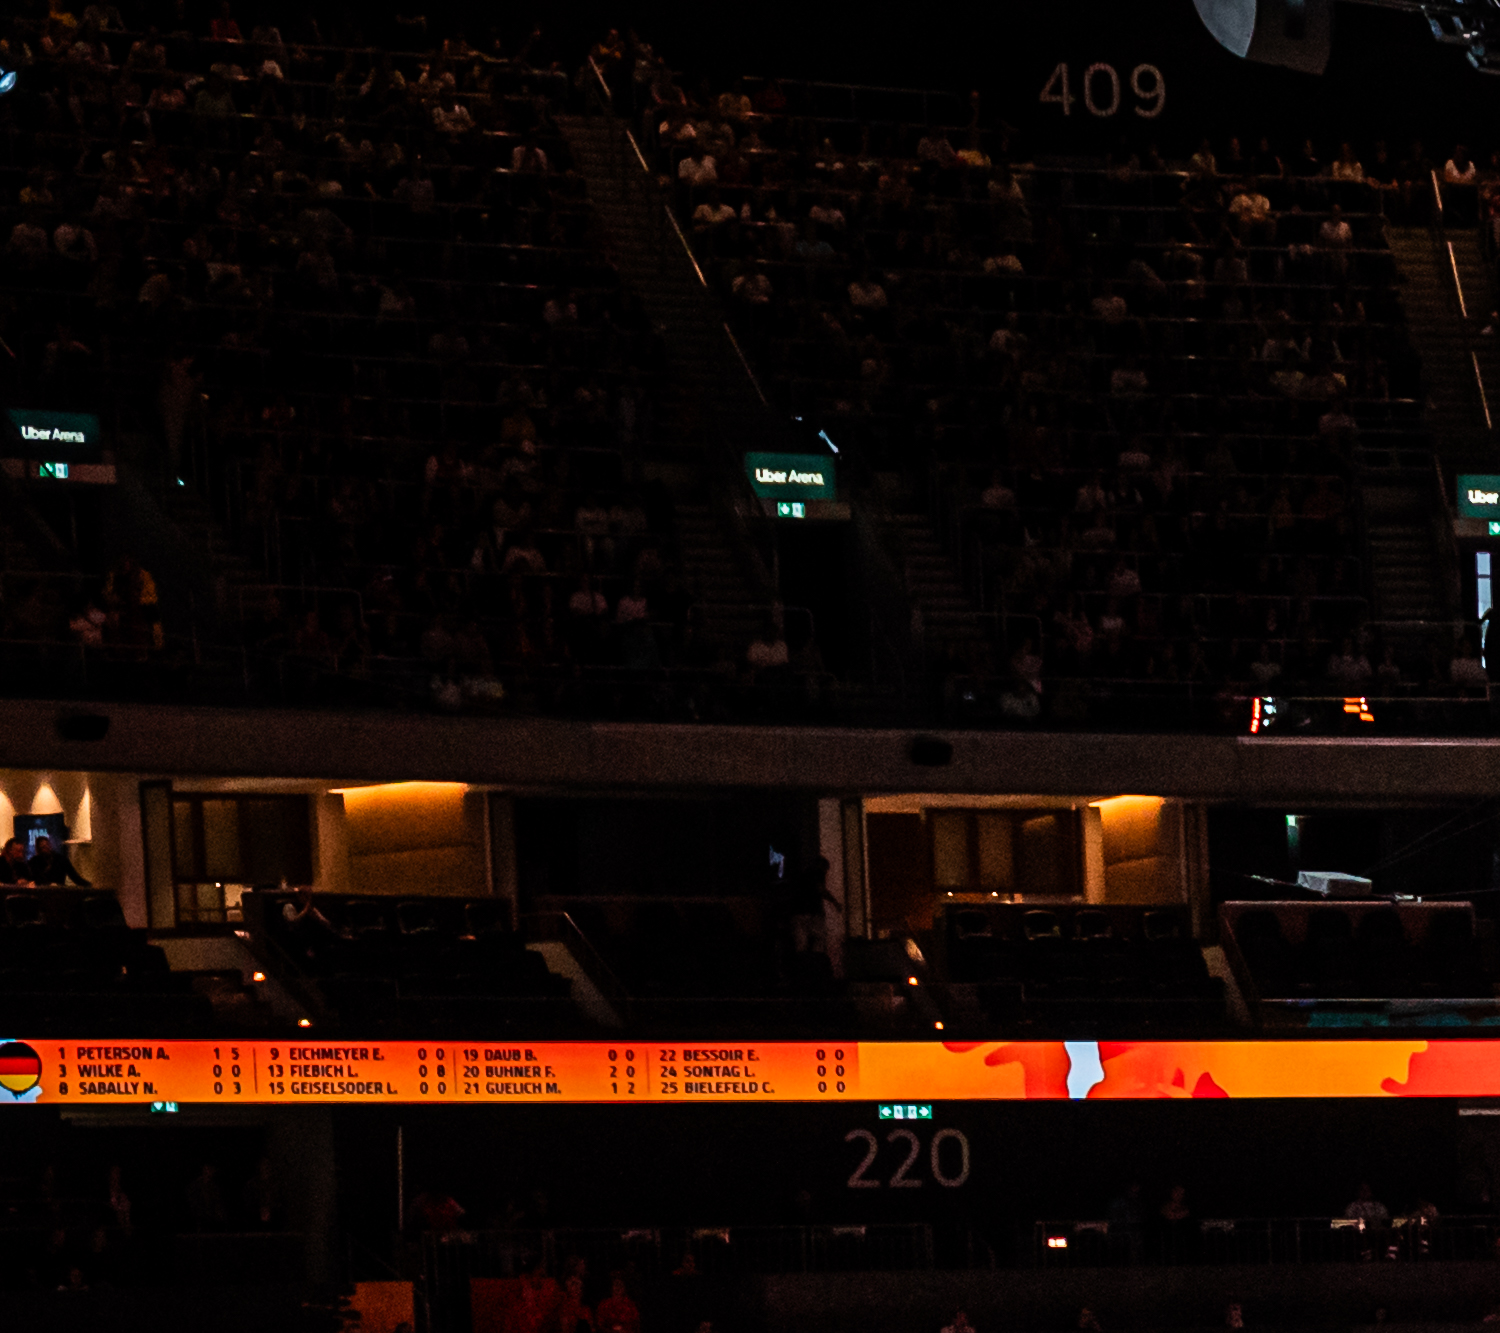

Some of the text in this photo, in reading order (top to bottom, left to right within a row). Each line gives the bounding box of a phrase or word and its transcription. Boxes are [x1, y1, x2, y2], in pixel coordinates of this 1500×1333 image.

[1041, 61, 1166, 116] 409
[22, 426, 86, 443] Uber Arena
[755, 468, 826, 486] Uber Arena
[1468, 489, 1499, 505] Uber
[77, 1047, 152, 1060] PETERSON
[78, 1064, 123, 1077] WILKE
[79, 1082, 138, 1095] SABALLY
[846, 1128, 970, 1187] 220
